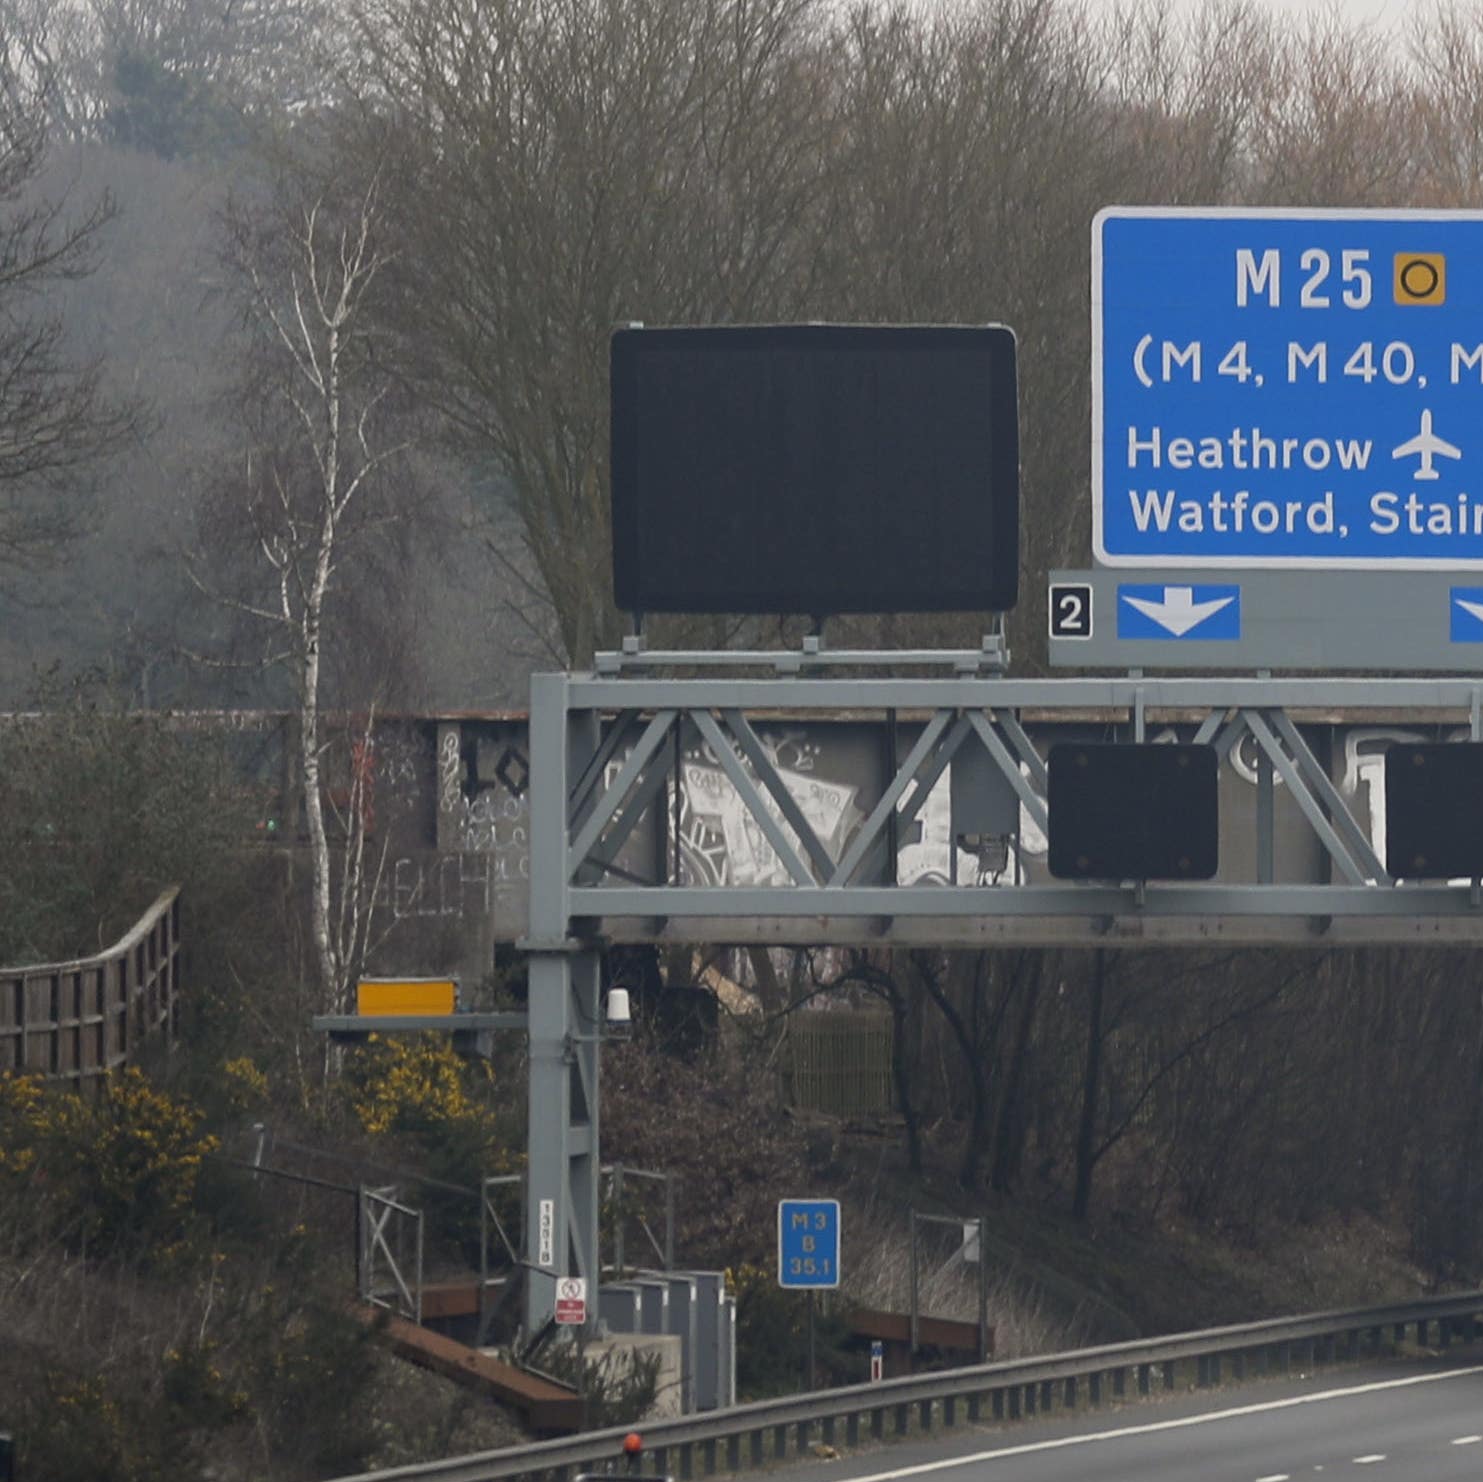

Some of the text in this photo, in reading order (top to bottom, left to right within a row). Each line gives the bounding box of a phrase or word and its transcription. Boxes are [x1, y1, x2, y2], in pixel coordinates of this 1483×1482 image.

[1128, 426, 1373, 470] Heathrow
[1129, 490, 1348, 537] Watford,
[1060, 594, 1081, 629] 2
